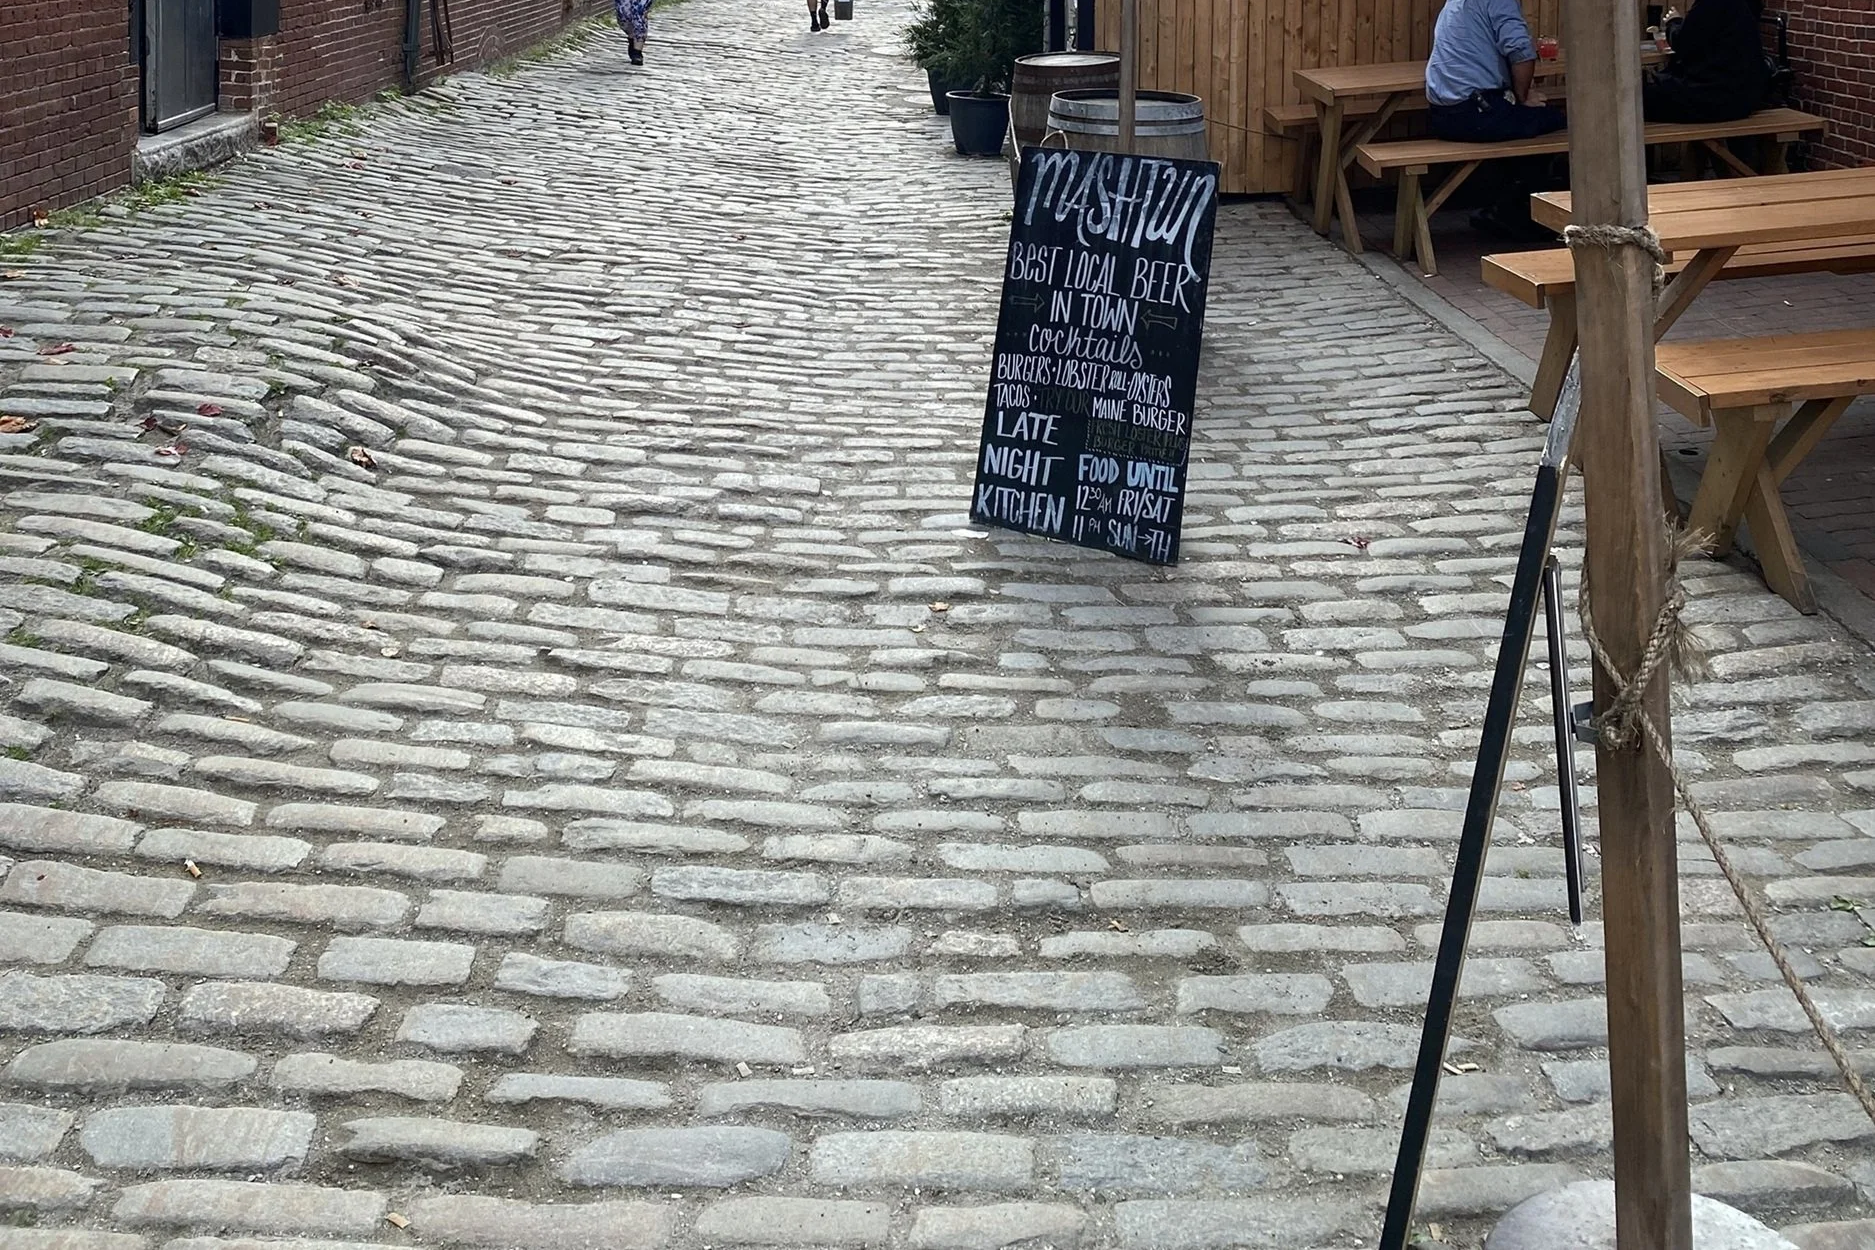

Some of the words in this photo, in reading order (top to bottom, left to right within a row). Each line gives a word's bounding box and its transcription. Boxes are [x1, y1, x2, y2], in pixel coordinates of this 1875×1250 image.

[1064, 249, 1120, 297] LOCAL
[1130, 257, 1191, 314] BEER
[1049, 290, 1073, 324] IN
[1080, 293, 1139, 335] TOWN
[993, 382, 1031, 409] TACOS
[1092, 397, 1127, 422] MAINE
[997, 411, 1061, 445] LATE
[984, 443, 1065, 486] NIGHT
[1078, 454, 1119, 484] FOOD
[1127, 461, 1178, 493] UNTIL
[976, 483, 1066, 534] KITCHEN
[1072, 515, 1084, 541] 11
[1088, 517, 1101, 534] PM
